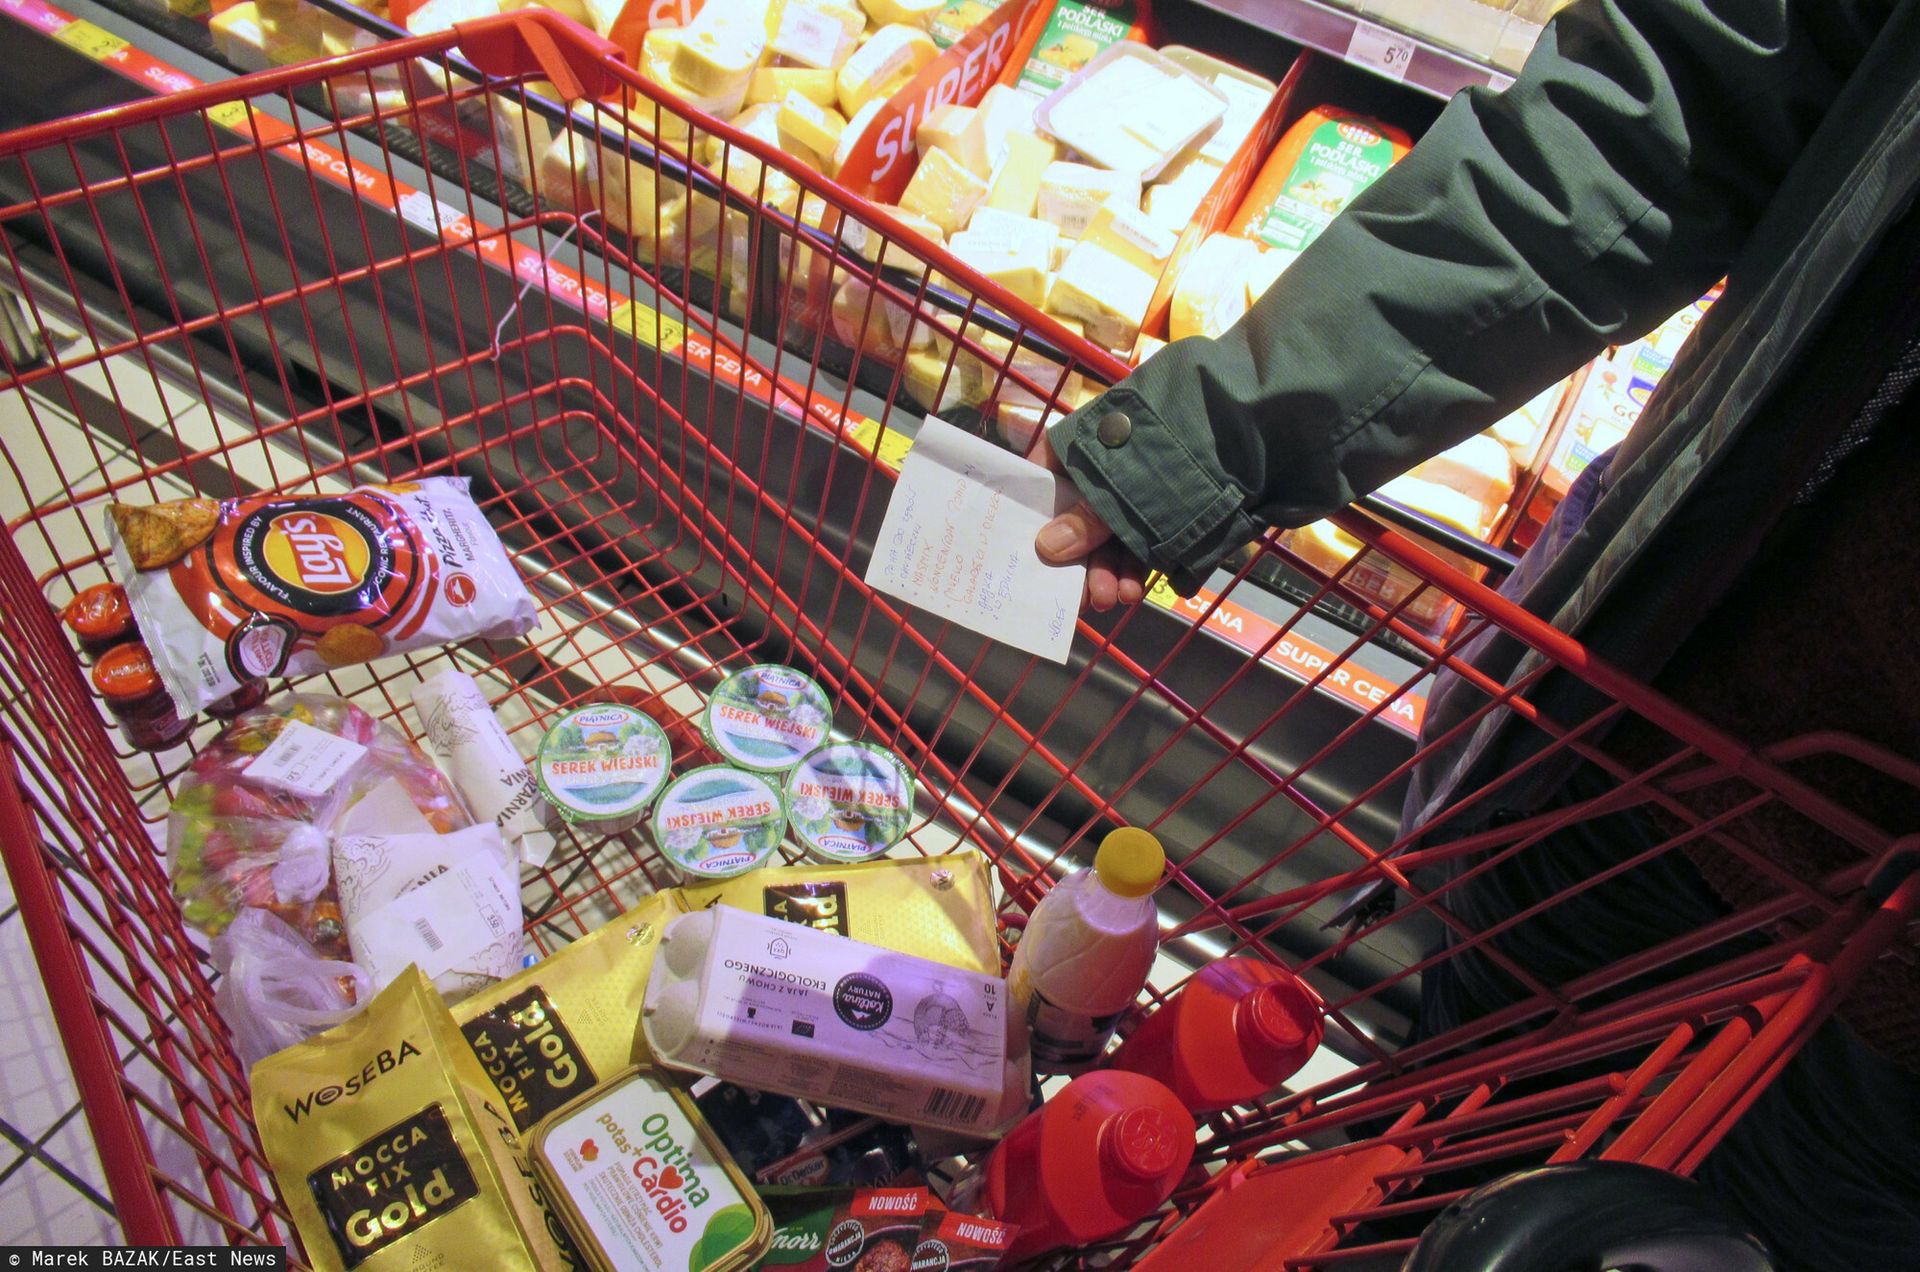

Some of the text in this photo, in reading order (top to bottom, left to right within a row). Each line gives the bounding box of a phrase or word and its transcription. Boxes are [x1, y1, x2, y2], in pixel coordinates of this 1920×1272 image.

[450, 219, 498, 252] CEA
[346, 506, 389, 555] REAURANT
[433, 526, 463, 568] Pizza
[242, 515, 290, 601] FLAVOUR INSPIRED BY
[280, 518, 352, 584] Lay's
[1184, 595, 1244, 633] CENA
[759, 671, 803, 688] PIĄTNICA
[1276, 641, 1349, 687] SUPER
[578, 712, 624, 726] PIĄTNICA
[719, 706, 817, 740] SEREK WIEJSKI
[552, 755, 658, 776] SEREK WIEJSKI
[799, 783, 901, 807] SEREK WIEJSKI
[666, 801, 772, 830] SEREK WIEJSKI
[704, 855, 752, 870] PIĄTNICA
[724, 959, 826, 991] EKOLOGICZNEGO
[739, 974, 809, 997] JAJA Z CHOWU
[984, 983, 996, 995] 10
[842, 993, 884, 1013] Kotlina
[848, 985, 880, 999] NATURY
[986, 1001, 995, 1012] A
[503, 1039, 536, 1080] FIX
[511, 999, 579, 1089] Gold
[283, 1040, 422, 1125] WOSEBA
[473, 1031, 529, 1113] MOCCA
[596, 1112, 634, 1155] potas
[330, 1125, 429, 1191] MOCCA
[642, 1113, 710, 1208] Optima
[365, 1160, 412, 1197] FIX
[632, 1156, 688, 1233] Cardio
[345, 1167, 456, 1248] Gold
[868, 1192, 918, 1211] NOWOŚĆ
[772, 1227, 821, 1250] norr
[956, 1222, 1006, 1245] NOWOŚĆ
[912, 1256, 946, 1271] WARANCJA
